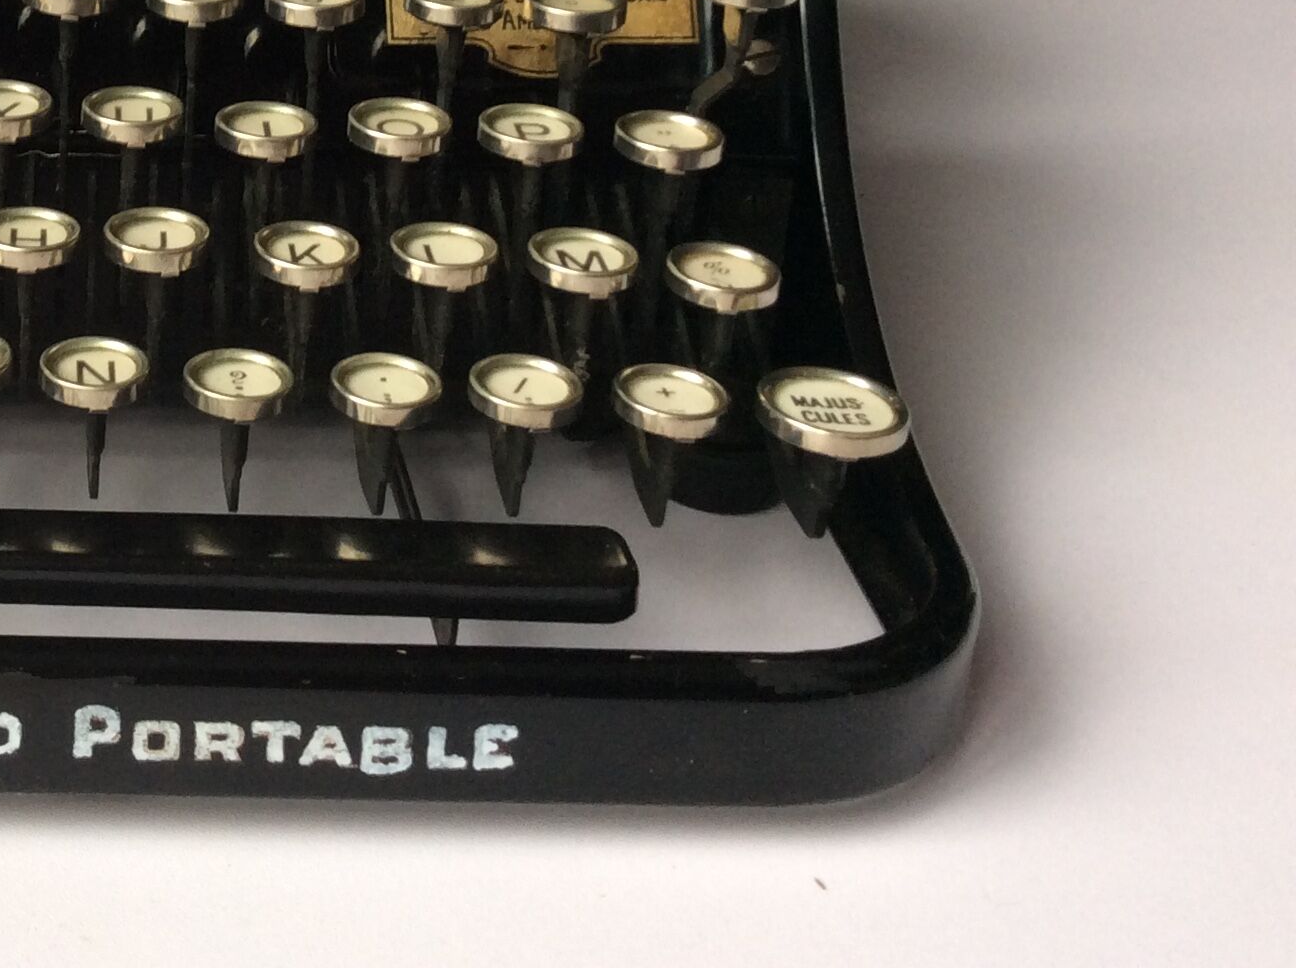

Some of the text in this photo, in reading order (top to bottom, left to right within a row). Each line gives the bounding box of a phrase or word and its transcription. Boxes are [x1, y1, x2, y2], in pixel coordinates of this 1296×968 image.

[377, 119, 424, 137] O
[514, 123, 551, 140] P
[9, 228, 48, 247] H
[140, 231, 168, 249] J
[289, 243, 324, 265] K
[556, 249, 609, 271] M
[75, 360, 116, 385] N
[801, 410, 872, 427] CULES
[72, 703, 518, 776] PORTABLE
